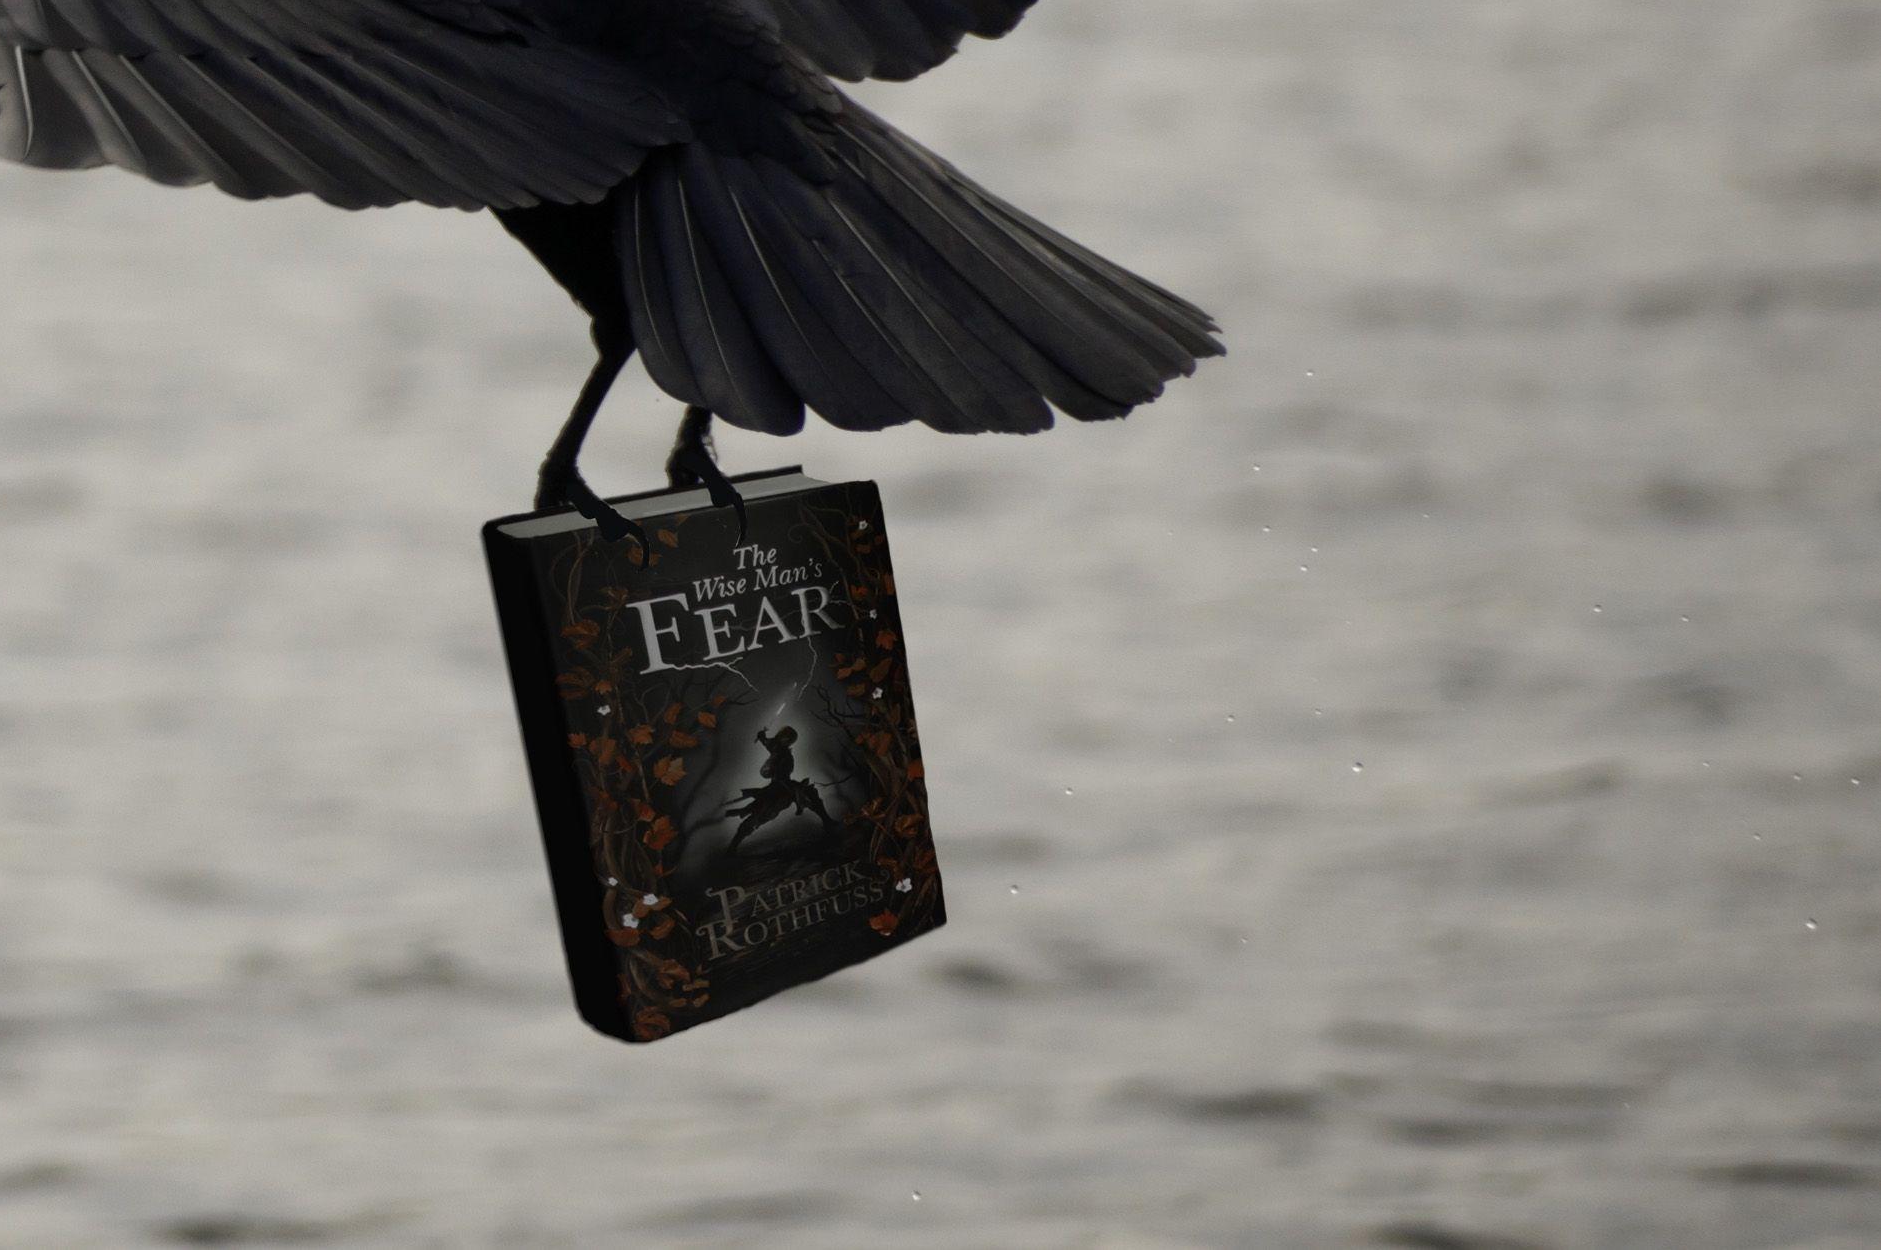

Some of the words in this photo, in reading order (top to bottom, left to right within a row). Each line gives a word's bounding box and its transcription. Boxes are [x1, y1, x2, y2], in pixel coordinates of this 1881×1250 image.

[692, 575, 747, 602] Wise
[753, 557, 823, 592] Man's
[733, 544, 777, 570] The
[625, 585, 846, 675] FEAR
[695, 871, 889, 961] ROTHFUSS
[705, 859, 873, 927] PATRICK
